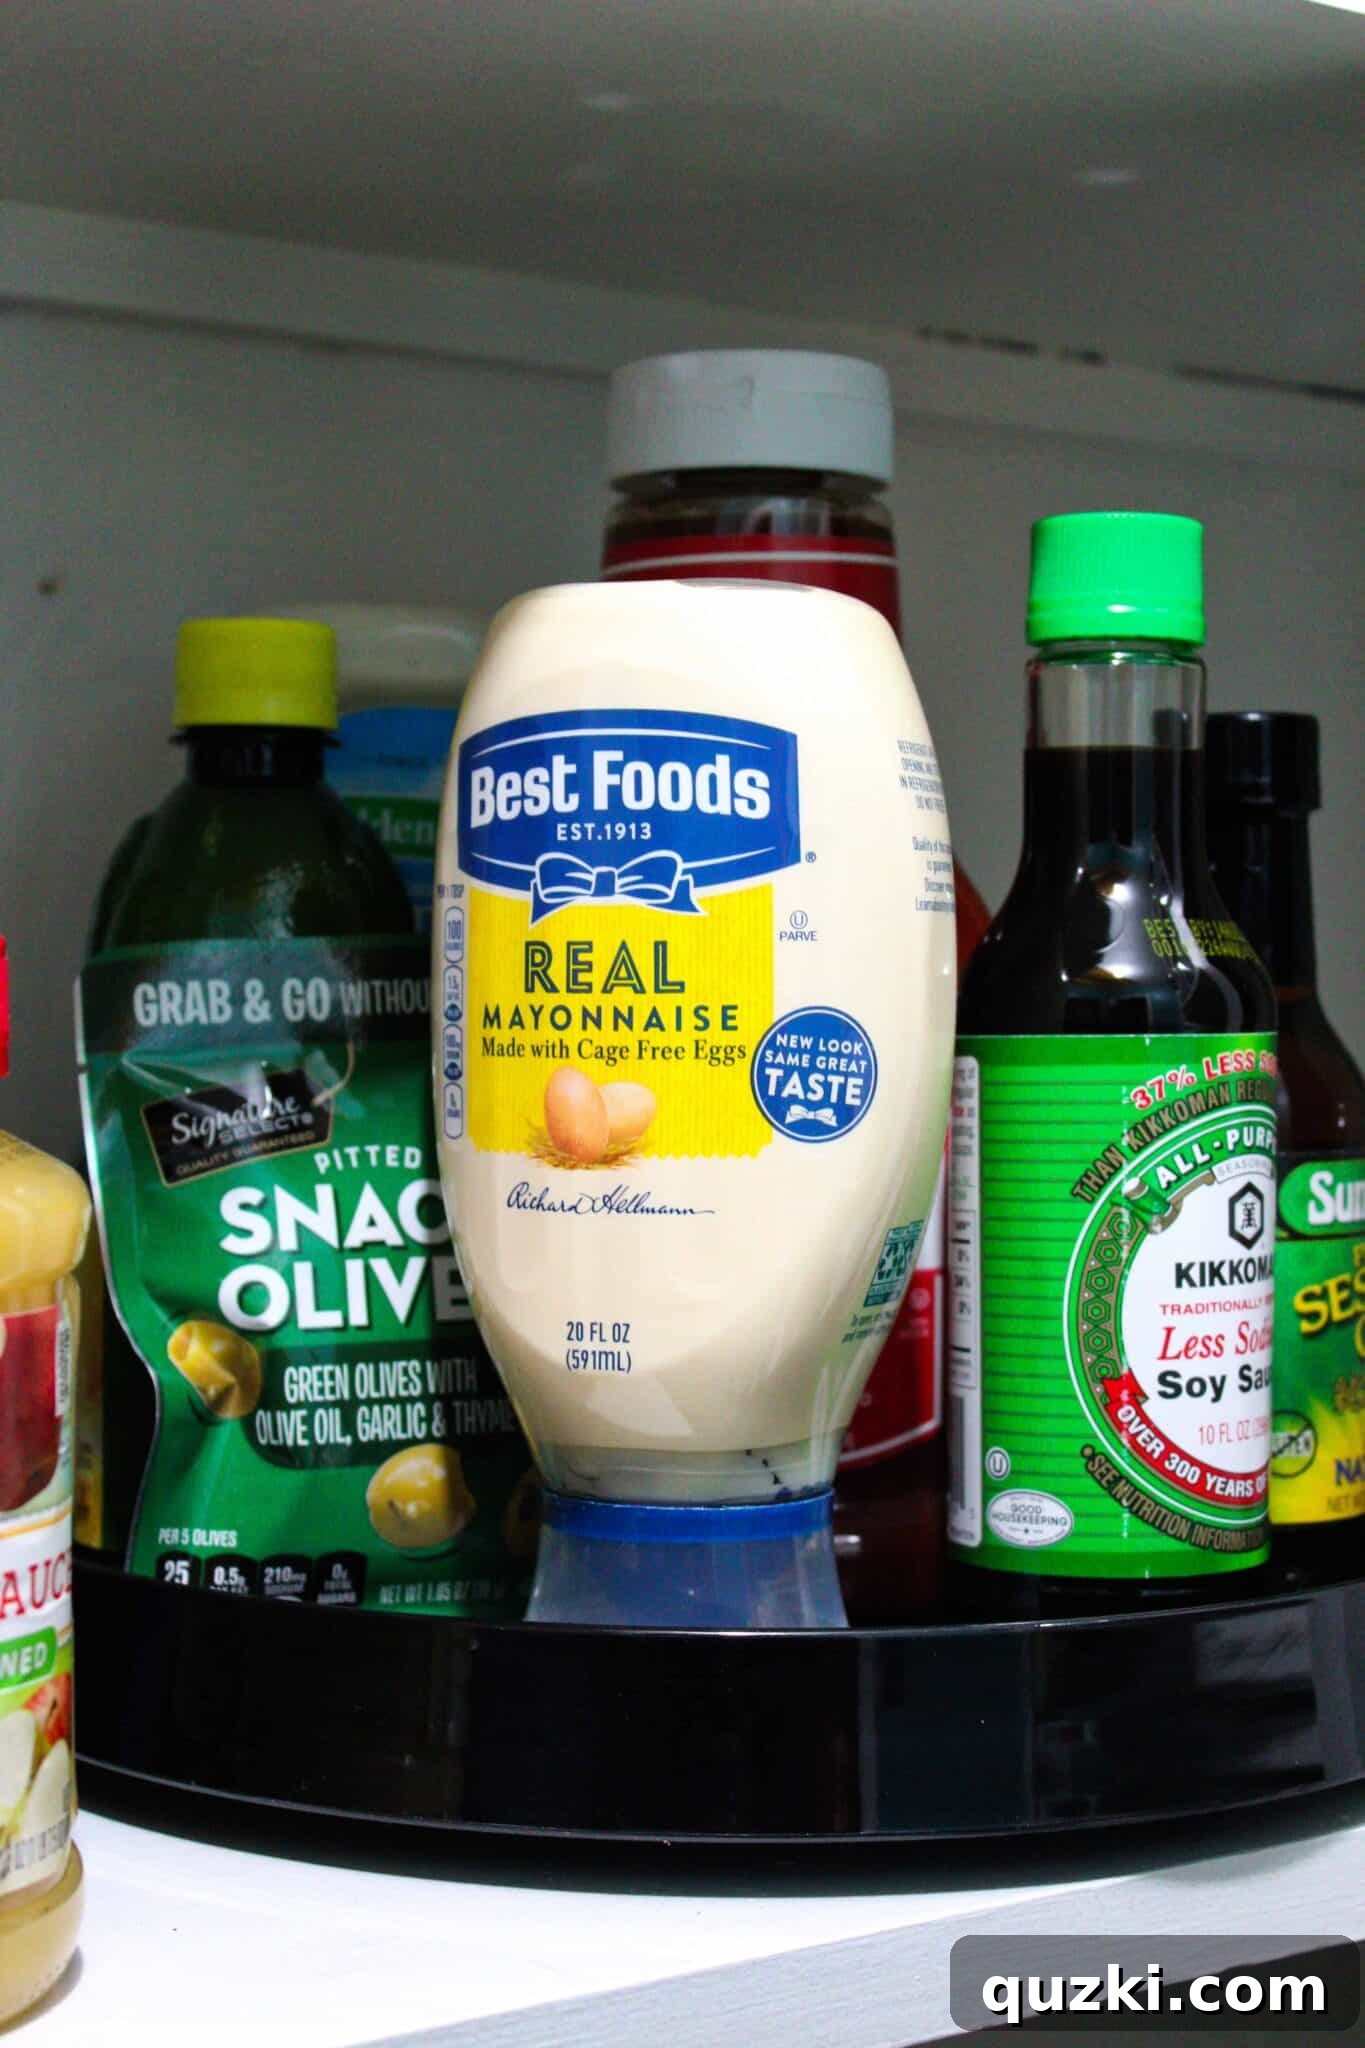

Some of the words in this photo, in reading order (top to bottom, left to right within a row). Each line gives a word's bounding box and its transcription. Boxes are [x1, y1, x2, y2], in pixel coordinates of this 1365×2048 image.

[470, 754, 579, 829] Best
[593, 750, 770, 820] Foods
[556, 822, 652, 842] EST.1913
[779, 930, 817, 942] PARVE
[524, 940, 685, 994] REAL
[133, 978, 232, 1027] GRAB
[243, 978, 272, 1025] &
[282, 977, 330, 1022] GO
[482, 1003, 739, 1032] MAYONNAISE
[482, 1036, 526, 1058] Made
[530, 1037, 570, 1060] with
[577, 1038, 630, 1067] Cage
[637, 1039, 686, 1061] Free
[693, 1039, 747, 1067] Eggs
[764, 1049, 811, 1068] SAME
[815, 1055, 868, 1074] GREAT
[776, 1033, 814, 1050] NEW
[818, 1037, 864, 1056] LOOK
[764, 1066, 864, 1107] TASTE
[1130, 1063, 1198, 1111] 37%
[1202, 1051, 1256, 1080] LESS
[171, 1095, 299, 1149] Signature
[1073, 1145, 1127, 1202] THAN
[1125, 1083, 1231, 1151] KIKKOMAN
[314, 1145, 422, 1175] PITTED
[506, 1181, 598, 1215] Richard
[594, 1184, 716, 1215] Hellmann
[566, 1321, 584, 1342] 20
[588, 1322, 607, 1343] FL
[611, 1323, 631, 1344] OZ
[1157, 1325, 1225, 1361] Less
[283, 1363, 350, 1405] GREEN
[354, 1360, 422, 1401] OLIVES
[425, 1358, 478, 1396] WITH
[1156, 1370, 1227, 1404] Soy
[255, 1408, 310, 1448] OLIVE
[314, 1407, 352, 1448] OIL,
[356, 1402, 427, 1443] GARLIC
[431, 1402, 448, 1438] &
[1198, 1422, 1216, 1447] 10
[1218, 1422, 1233, 1444] FL
[1236, 1418, 1250, 1441] OZ
[1116, 1404, 1166, 1460] OVER
[1164, 1452, 1201, 1485] 300
[1204, 1471, 1254, 1498] YEARS
[1010, 1503, 1042, 1514] GOOD
[1088, 1454, 1119, 1488] SEE
[1112, 1479, 1192, 1541] NUTRITION
[991, 1512, 1068, 1527] HOUSEKEEPING
[158, 1527, 180, 1546] PER
[181, 1527, 190, 1546] 5
[192, 1528, 238, 1548] OLIVES
